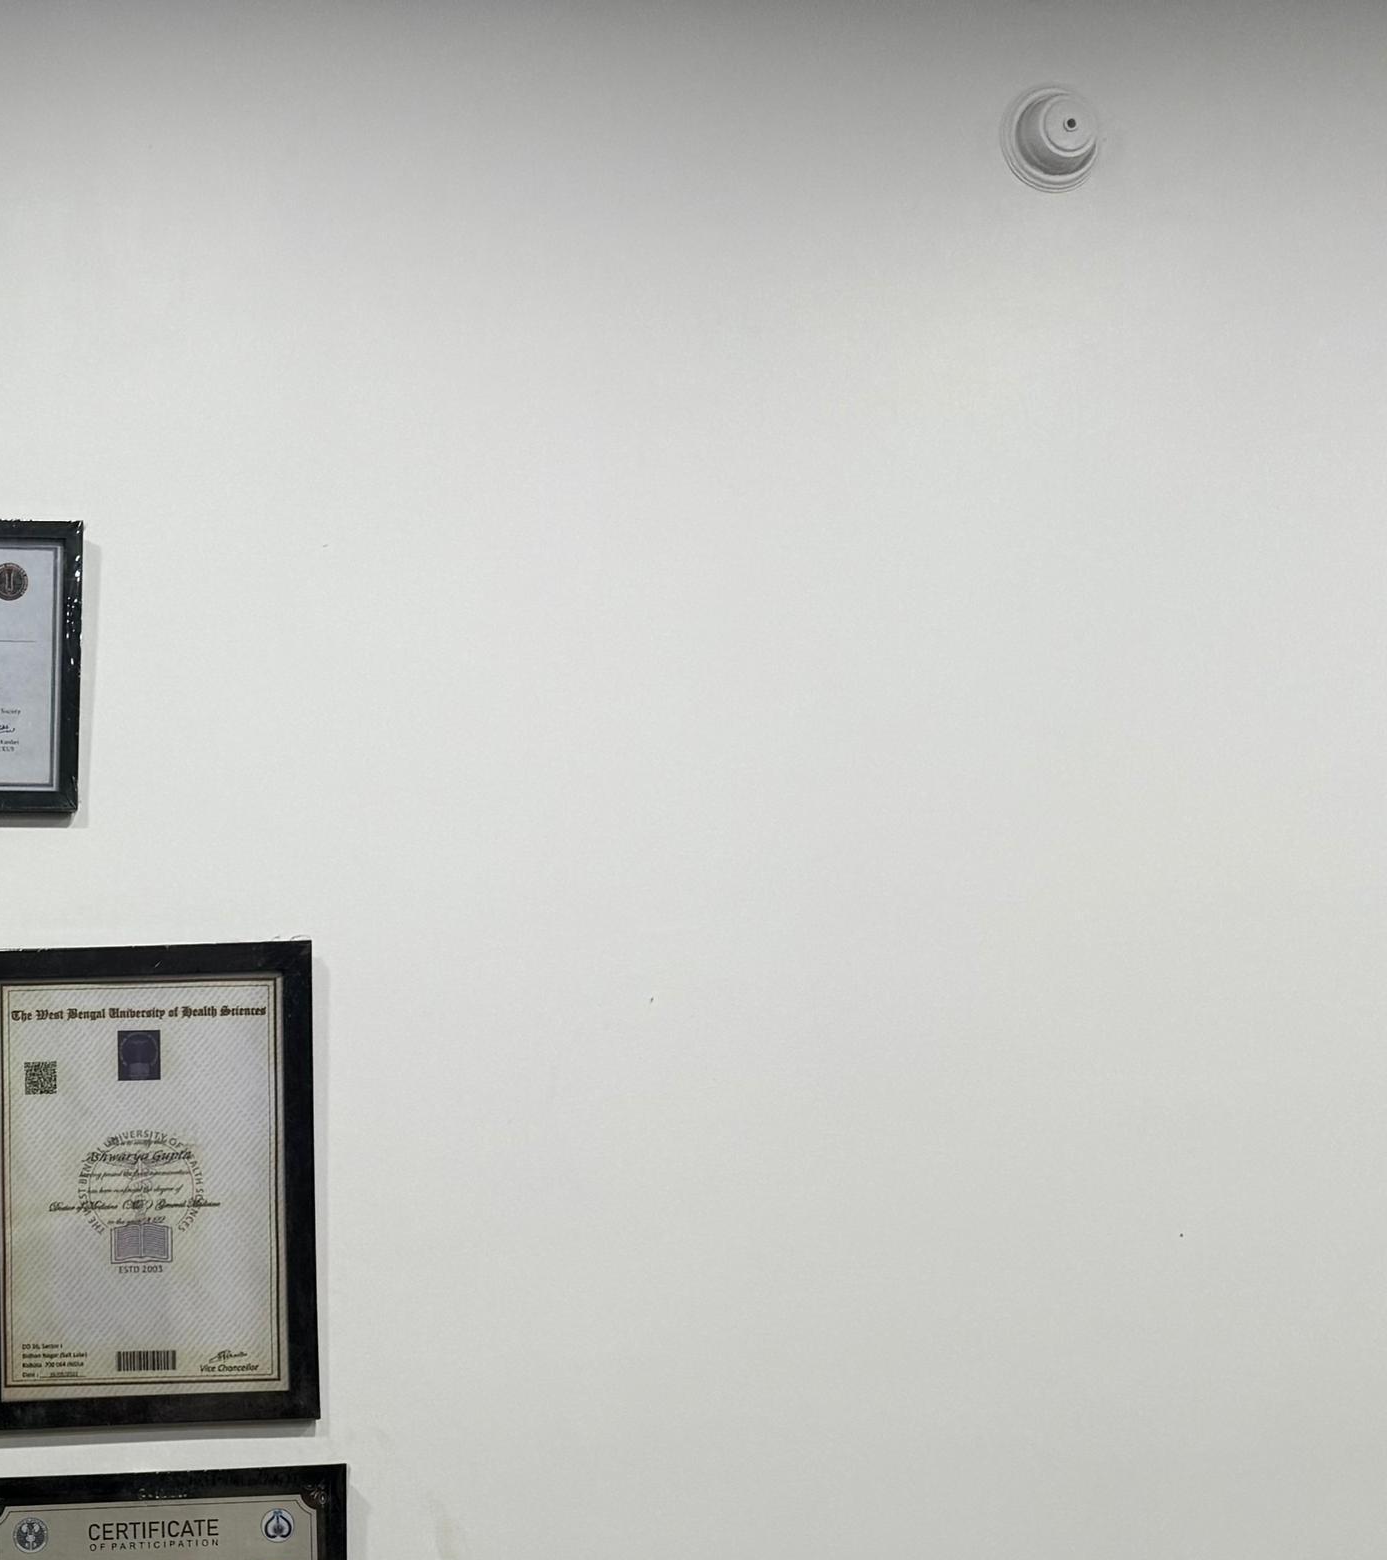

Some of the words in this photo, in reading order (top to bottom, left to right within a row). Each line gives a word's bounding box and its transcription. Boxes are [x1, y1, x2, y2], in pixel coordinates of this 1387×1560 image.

[11, 1010, 32, 1022] The
[35, 1009, 64, 1021] West
[67, 1008, 106, 1021] Bengal
[108, 1007, 166, 1020] University
[168, 1006, 179, 1017] of
[181, 1005, 217, 1019] Health
[220, 1005, 267, 1016] Sciences
[119, 1265, 140, 1274] ESTD
[142, 1264, 163, 1273] 2003
[200, 1364, 216, 1373] Vice
[217, 1363, 259, 1372] Chancellor
[88, 1519, 219, 1541] CERTIFICATE
[89, 1543, 105, 1552] OF
[111, 1539, 218, 1550] PARTICIPATION
